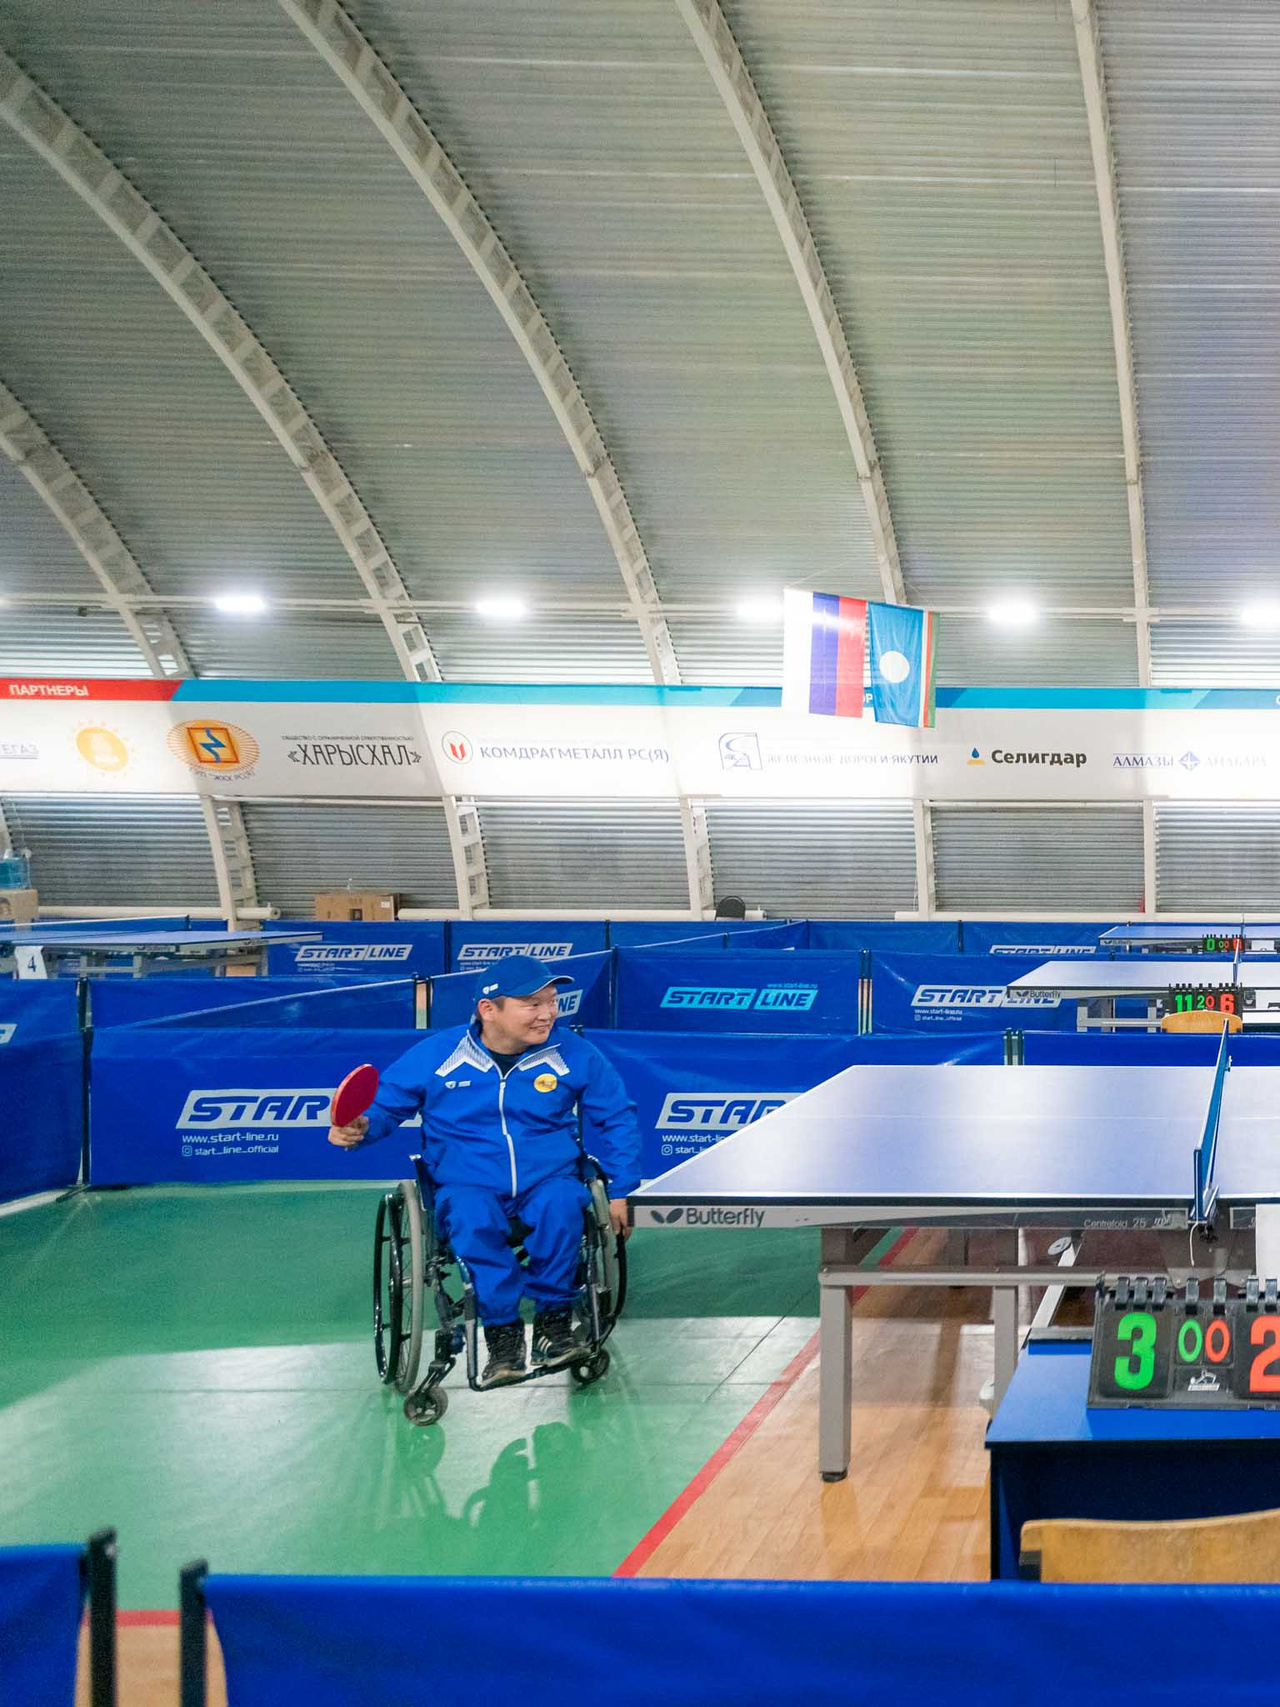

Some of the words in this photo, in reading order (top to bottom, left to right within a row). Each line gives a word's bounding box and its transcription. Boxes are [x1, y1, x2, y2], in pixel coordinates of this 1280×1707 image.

[9, 684, 89, 697] ПАРТНЕРЫ
[287, 744, 422, 766] «ХАРЫСХАЛ»
[480, 746, 624, 761] КОМДРАГМЕТАЛЛ
[628, 748, 670, 763] РС(Я)
[891, 755, 939, 764] ЯКУТИИ
[991, 749, 1087, 768] Селигдар
[1113, 754, 1174, 767] АЛМАЗЫ
[463, 946, 524, 957] START
[529, 946, 567, 956] LINE
[1206, 938, 1215, 951] 0
[301, 948, 365, 958] START
[369, 947, 407, 958] LINE
[27, 955, 37, 973] 4
[667, 990, 752, 1006] START
[760, 992, 811, 1006] LINE
[917, 988, 1003, 1003] START
[1029, 990, 1061, 999] Butterfly
[1175, 994, 1193, 1012] 11
[1197, 995, 1205, 1008] 2
[1206, 994, 1215, 1008] 0
[1220, 993, 1235, 1014] 6
[188, 1095, 331, 1122] STAR
[182, 1132, 279, 1143] www.start-line.ru
[194, 1145, 279, 1156] start_line_official
[685, 1207, 765, 1227] Butterfly
[1132, 1216, 1146, 1228] 25
[1114, 1312, 1157, 1391] 3
[1177, 1319, 1203, 1362] 0
[1205, 1319, 1231, 1362] 0
